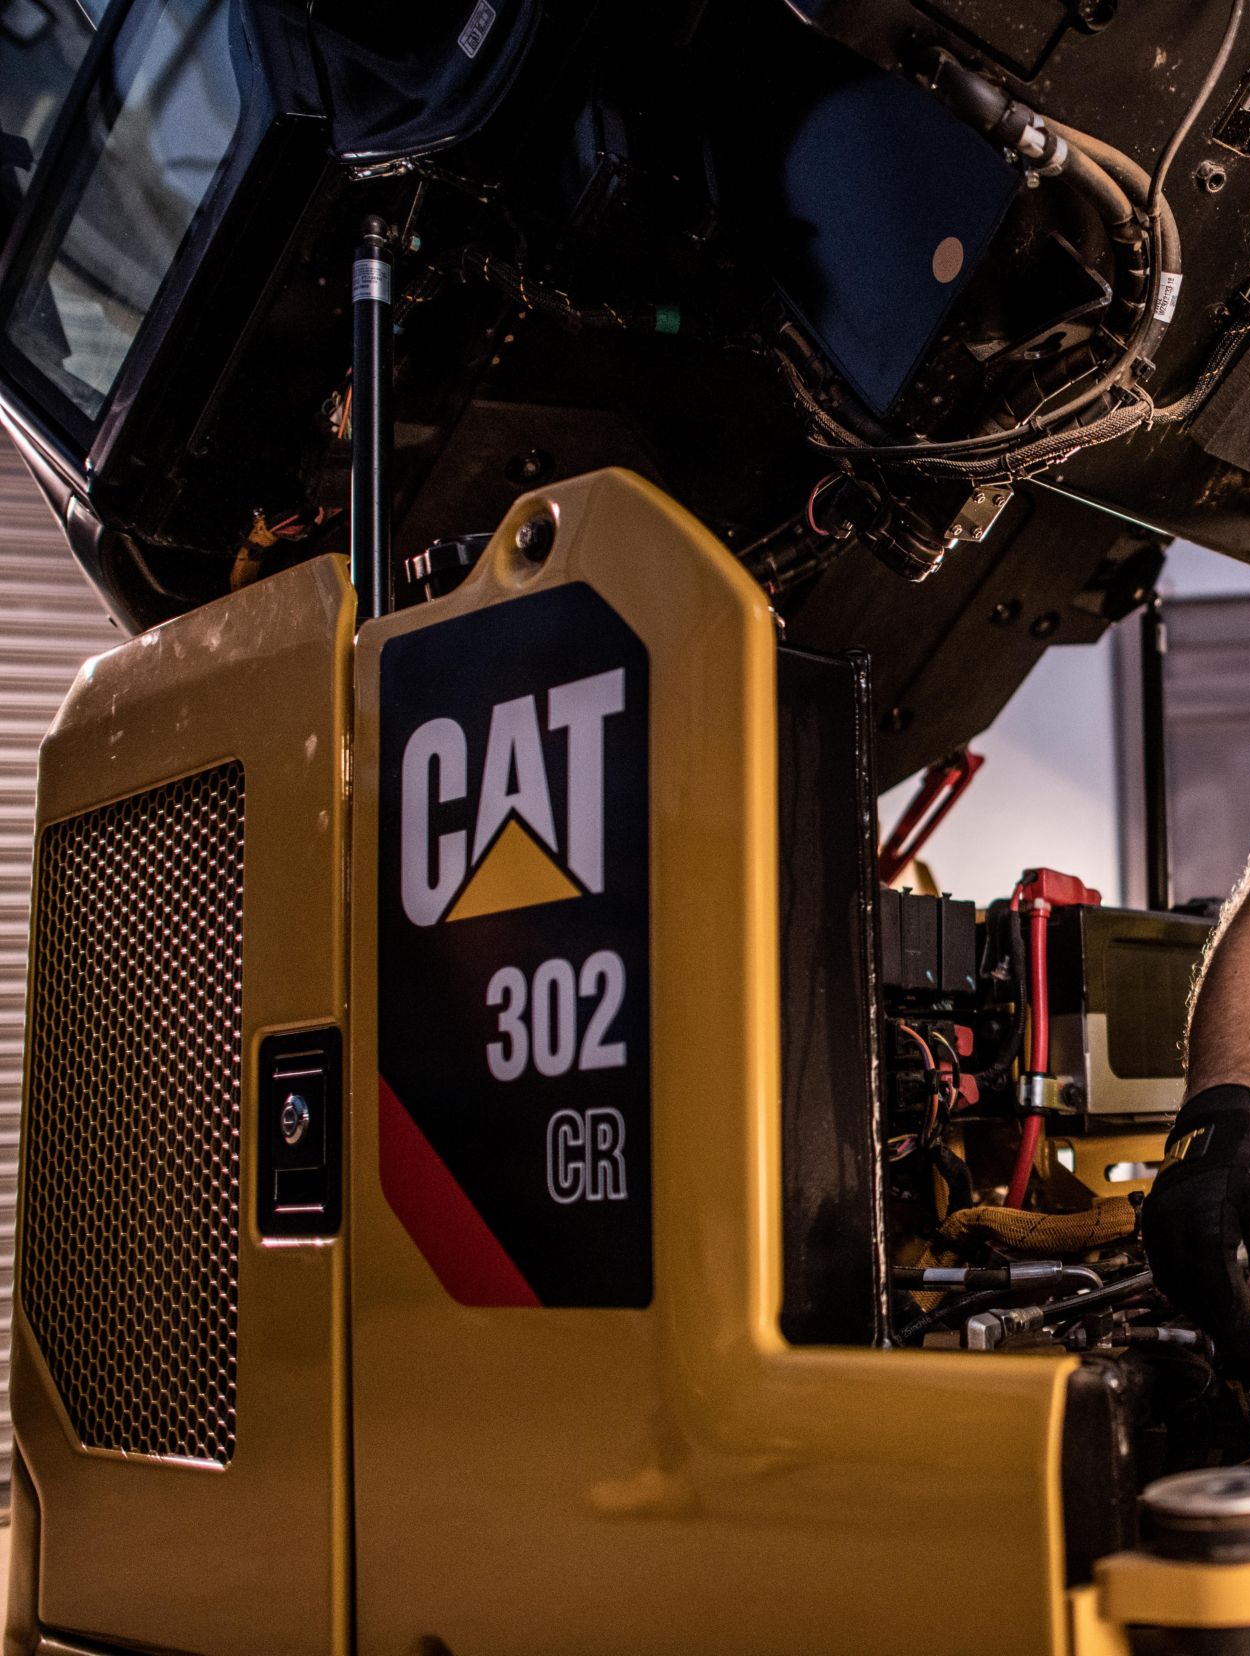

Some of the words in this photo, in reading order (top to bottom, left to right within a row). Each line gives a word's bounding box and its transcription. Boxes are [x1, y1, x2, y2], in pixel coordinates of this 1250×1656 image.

[401, 667, 625, 927] CAT
[486, 950, 627, 1081] 302
[547, 1107, 628, 1204] CR
